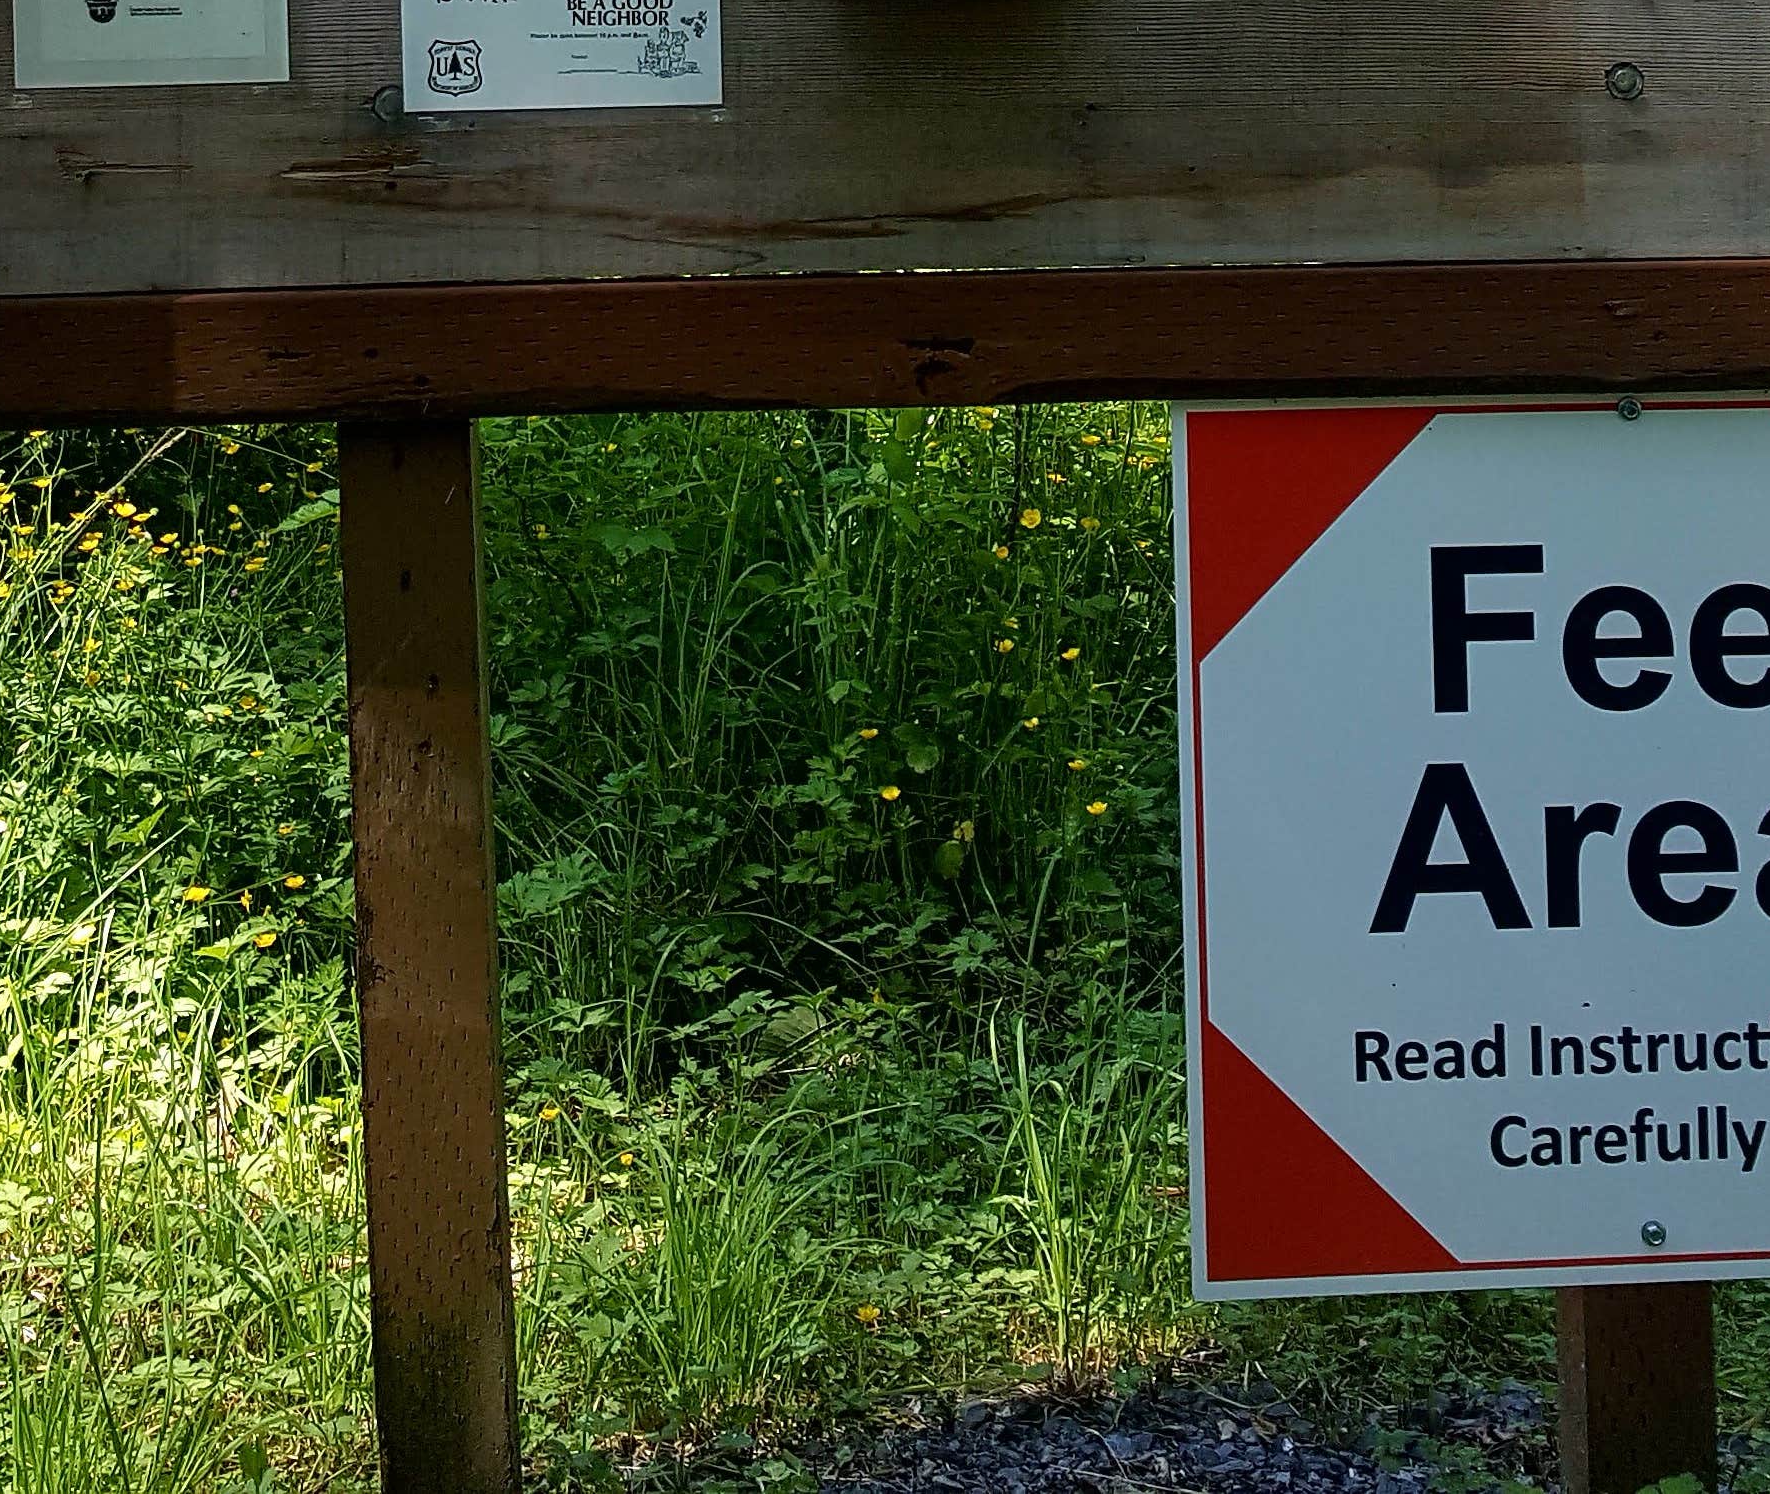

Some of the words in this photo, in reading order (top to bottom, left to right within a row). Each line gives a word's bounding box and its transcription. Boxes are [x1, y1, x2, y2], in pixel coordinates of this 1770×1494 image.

[572, 10, 669, 26] NEIGHBOR
[1354, 1023, 1506, 1082] Read
[1490, 1105, 1767, 1175] Carefully
